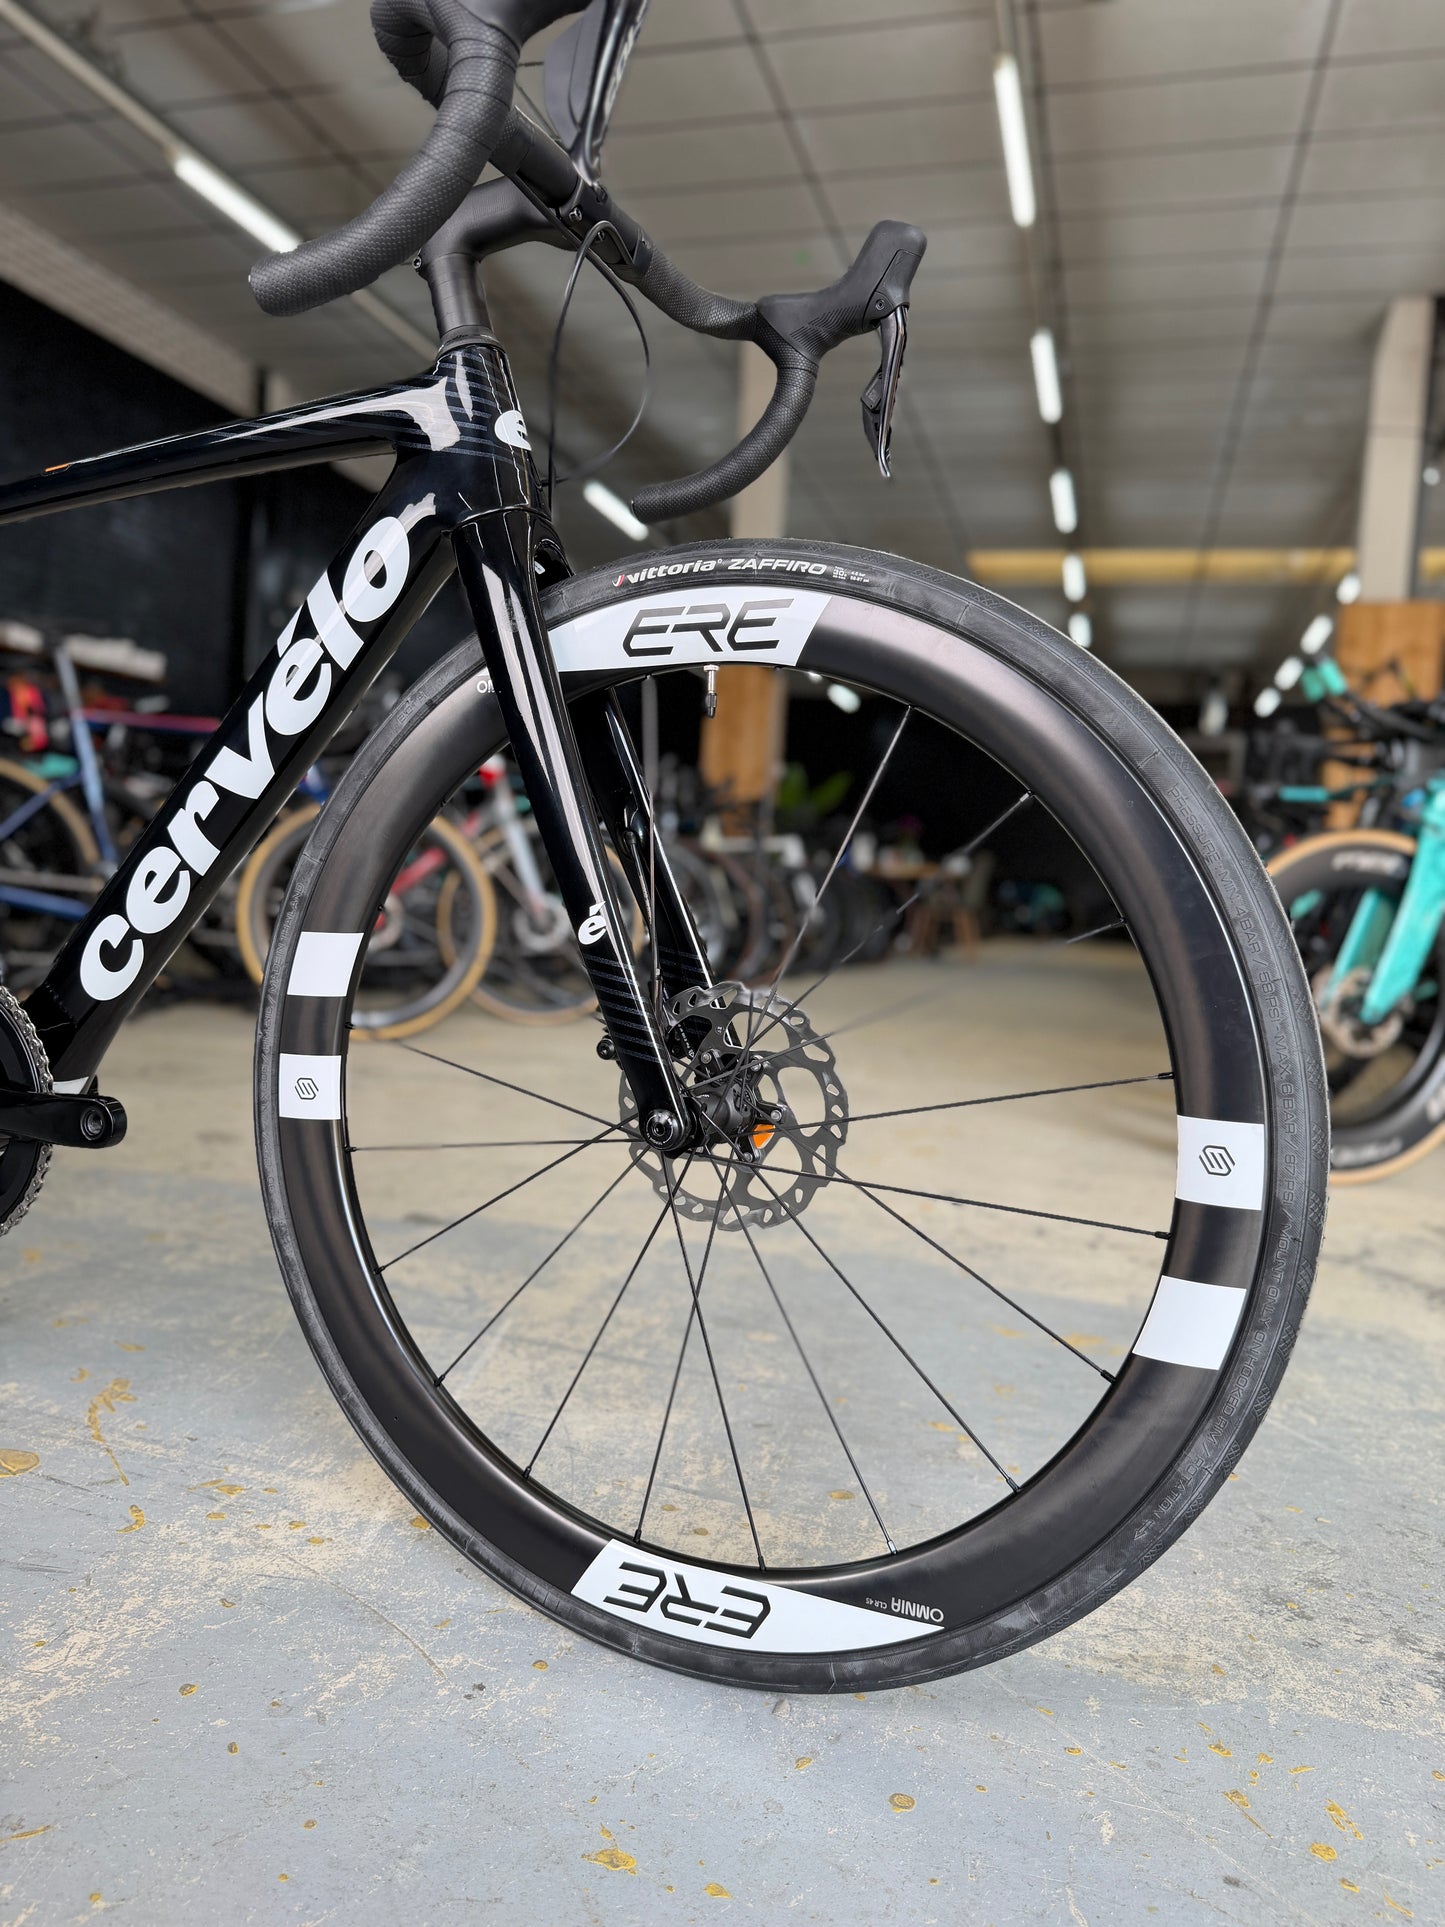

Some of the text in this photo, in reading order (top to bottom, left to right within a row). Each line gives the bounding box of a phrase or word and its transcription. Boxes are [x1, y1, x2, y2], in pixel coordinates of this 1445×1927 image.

[728, 558, 828, 576] ZAFFIRO
[622, 598, 795, 658] ERE
[79, 515, 410, 1002] cervélo
[577, 900, 607, 946] é
[1240, 918, 1261, 954] BAR
[1265, 996, 1281, 1023] PSI
[1274, 1034, 1292, 1080] MAX.
[1281, 1083, 1294, 1096] 6
[1283, 1098, 1296, 1136] BAR
[1284, 1153, 1296, 1177] 87
[1282, 1179, 1295, 1206] PSI
[1271, 1223, 1293, 1284] MOUNT
[1259, 1285, 1280, 1329] ONLY
[1248, 1329, 1266, 1355] ON
[1222, 1354, 1259, 1417] HOOKED
[1208, 1416, 1228, 1446] RIM
[1154, 1455, 1205, 1520] ROTATION
[603, 1561, 772, 1640] ERE
[874, 1599, 888, 1610] CLR
[891, 1596, 945, 1623] OMNIA
